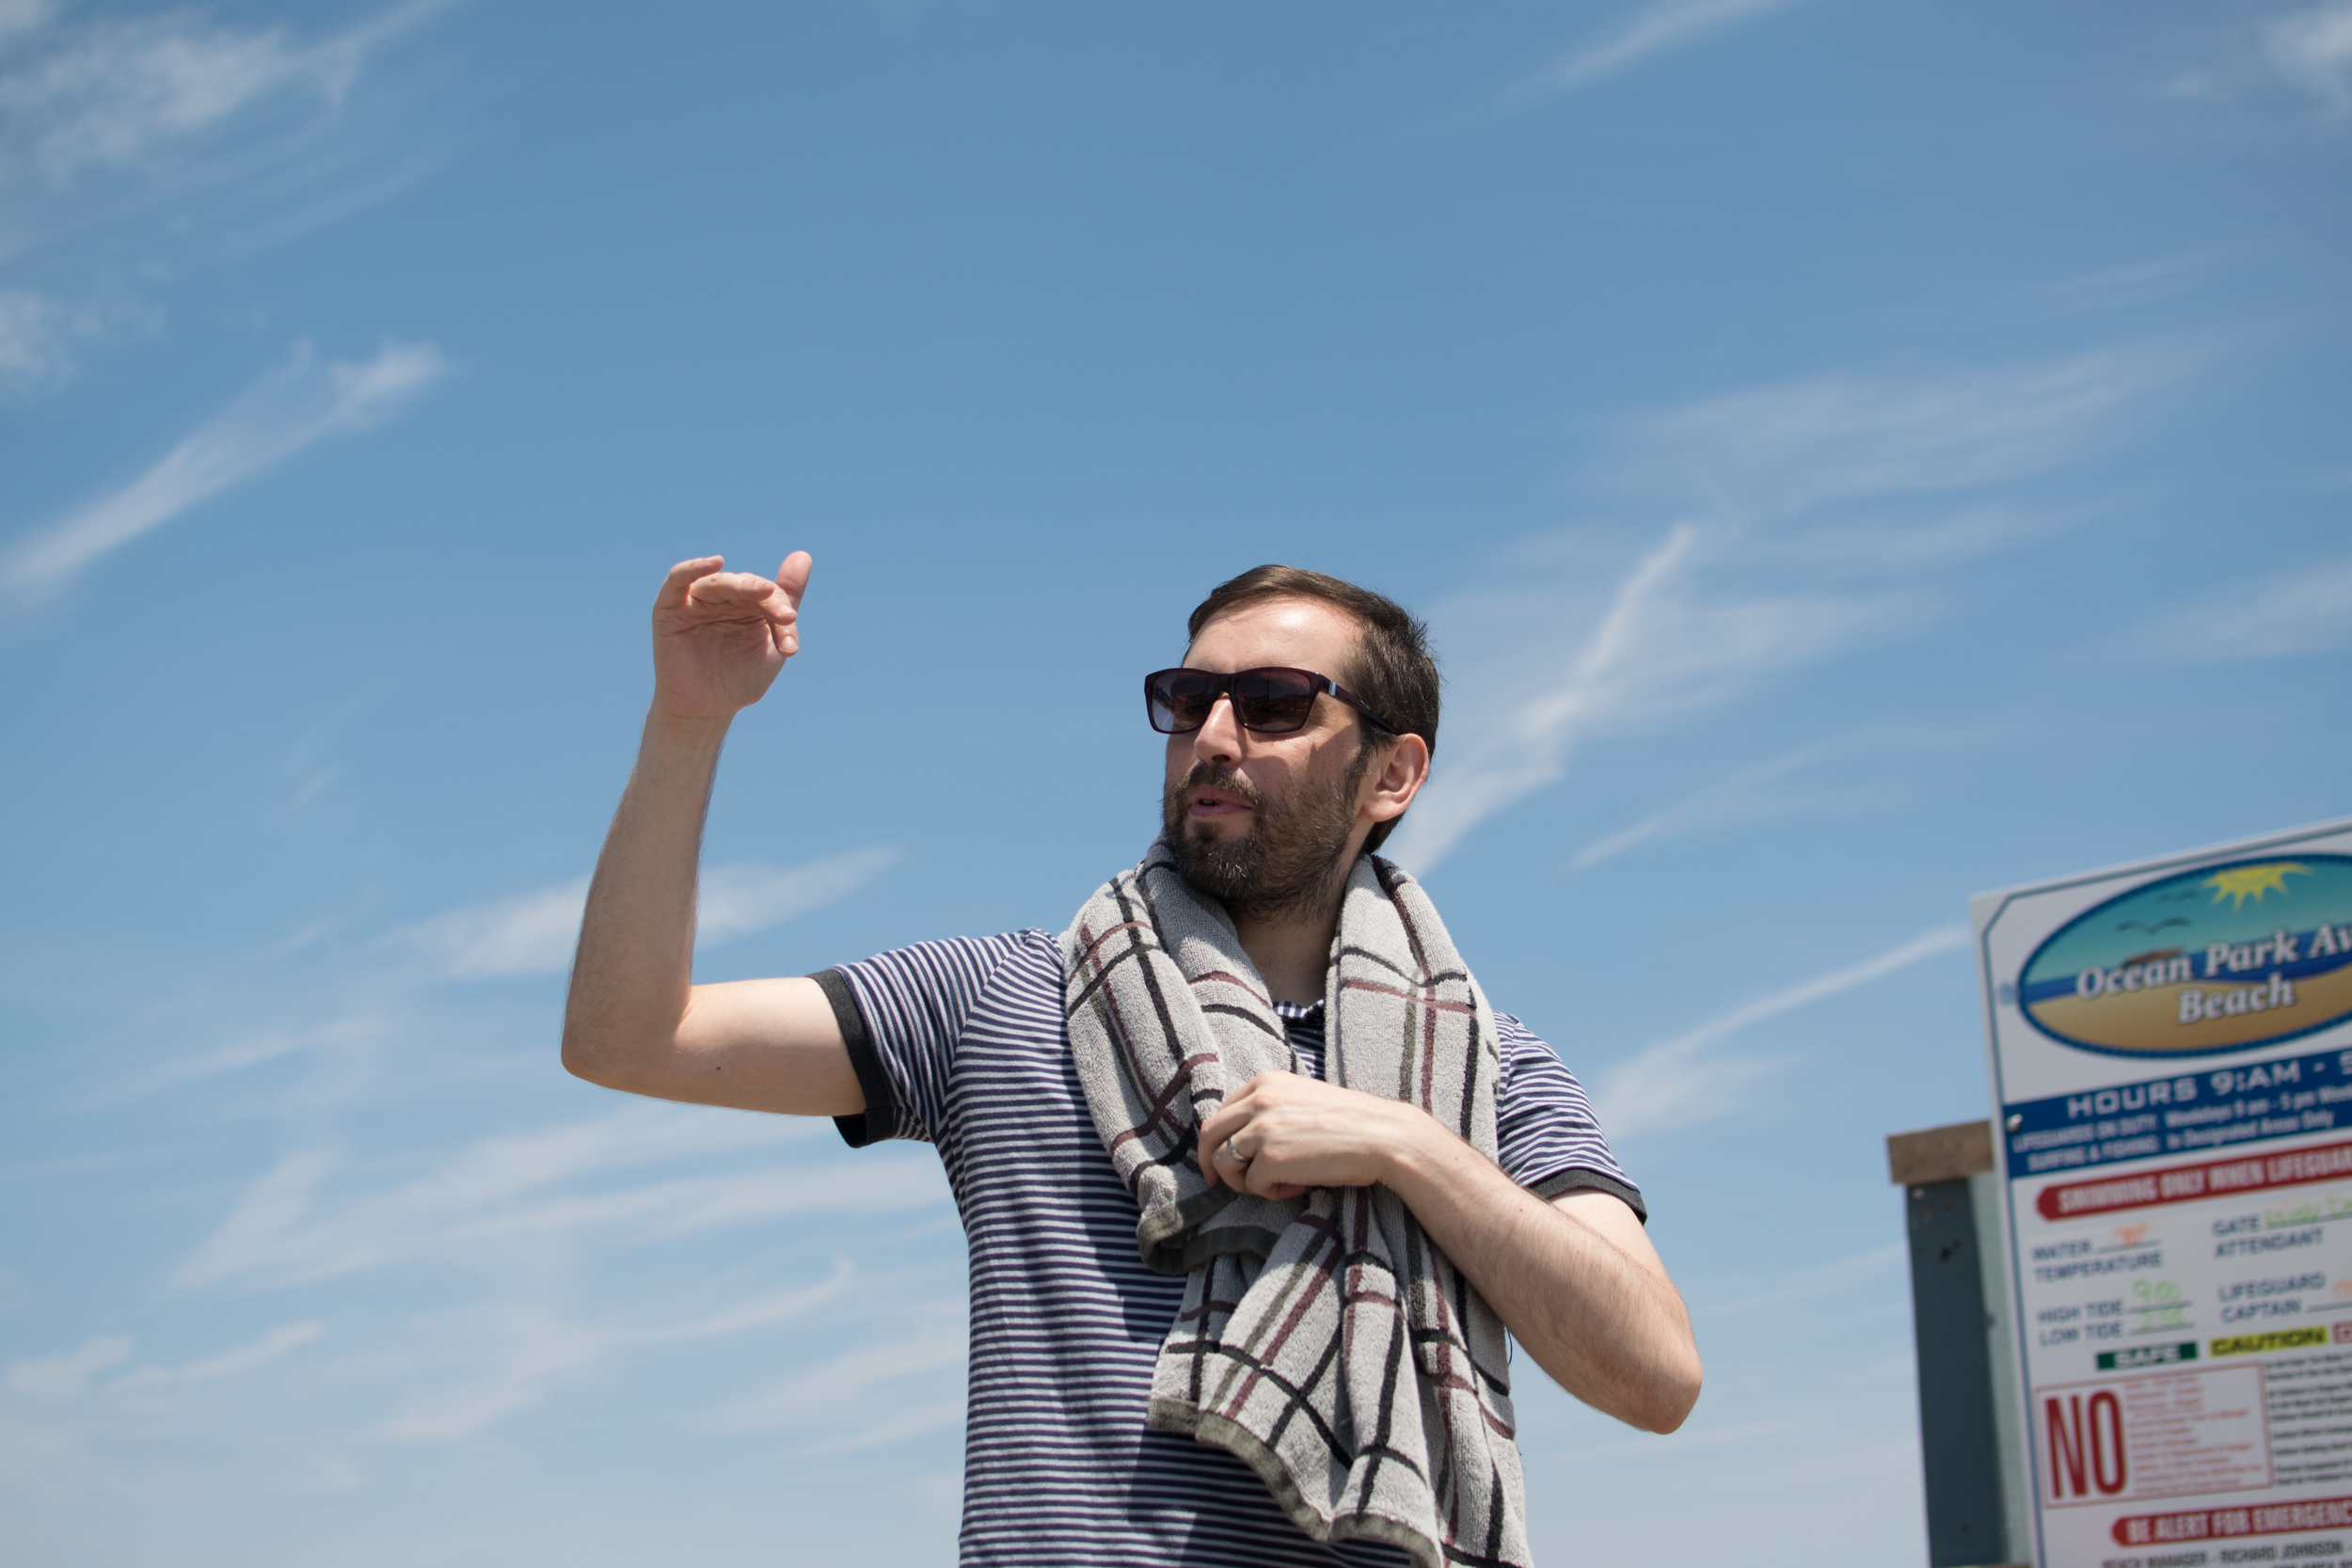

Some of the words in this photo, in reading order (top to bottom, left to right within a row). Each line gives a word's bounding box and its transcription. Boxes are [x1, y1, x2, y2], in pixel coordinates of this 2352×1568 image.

[2075, 956, 2193, 1001] Ocean
[2204, 927, 2300, 977] Park
[2177, 971, 2296, 1025] Beach
[2068, 1077, 2198, 1119] HOURS
[2211, 1060, 2301, 1096] 9:AM
[2097, 1119, 2116, 1140] ON
[2119, 1114, 2158, 1137] DUTY
[2165, 1104, 2233, 1129] Weekdays
[2183, 1119, 2258, 1146] Designated
[2260, 1115, 2301, 1135] Areas
[2301, 1109, 2335, 1130] Only
[2159, 1168, 2205, 1199] ONLY
[2208, 1157, 2265, 1191] WHEN
[2212, 1213, 2261, 1239] GATE
[2215, 1226, 2325, 1260] ATTENDANT
[2031, 1238, 2092, 1262] WATER
[2034, 1250, 2164, 1283] TEMPERATURE
[2217, 1272, 2327, 1304] LIFEGUARD
[2037, 1305, 2082, 1325] HIGH
[2084, 1298, 2124, 1321] TIDE
[2220, 1298, 2302, 1324] CAPTAIN
[2039, 1326, 2080, 1347] LOW
[2085, 1319, 2124, 1341] TIDE
[2114, 1345, 2180, 1368] SAFE
[2211, 1328, 2326, 1356] CAUTION
[2045, 1389, 2127, 1499] NO
[2126, 1518, 2153, 1544] BE
[2153, 1513, 2210, 1543] ALERT
[2212, 1508, 2251, 1536] FOR
[2281, 1538, 2344, 1560] JOHNSON
